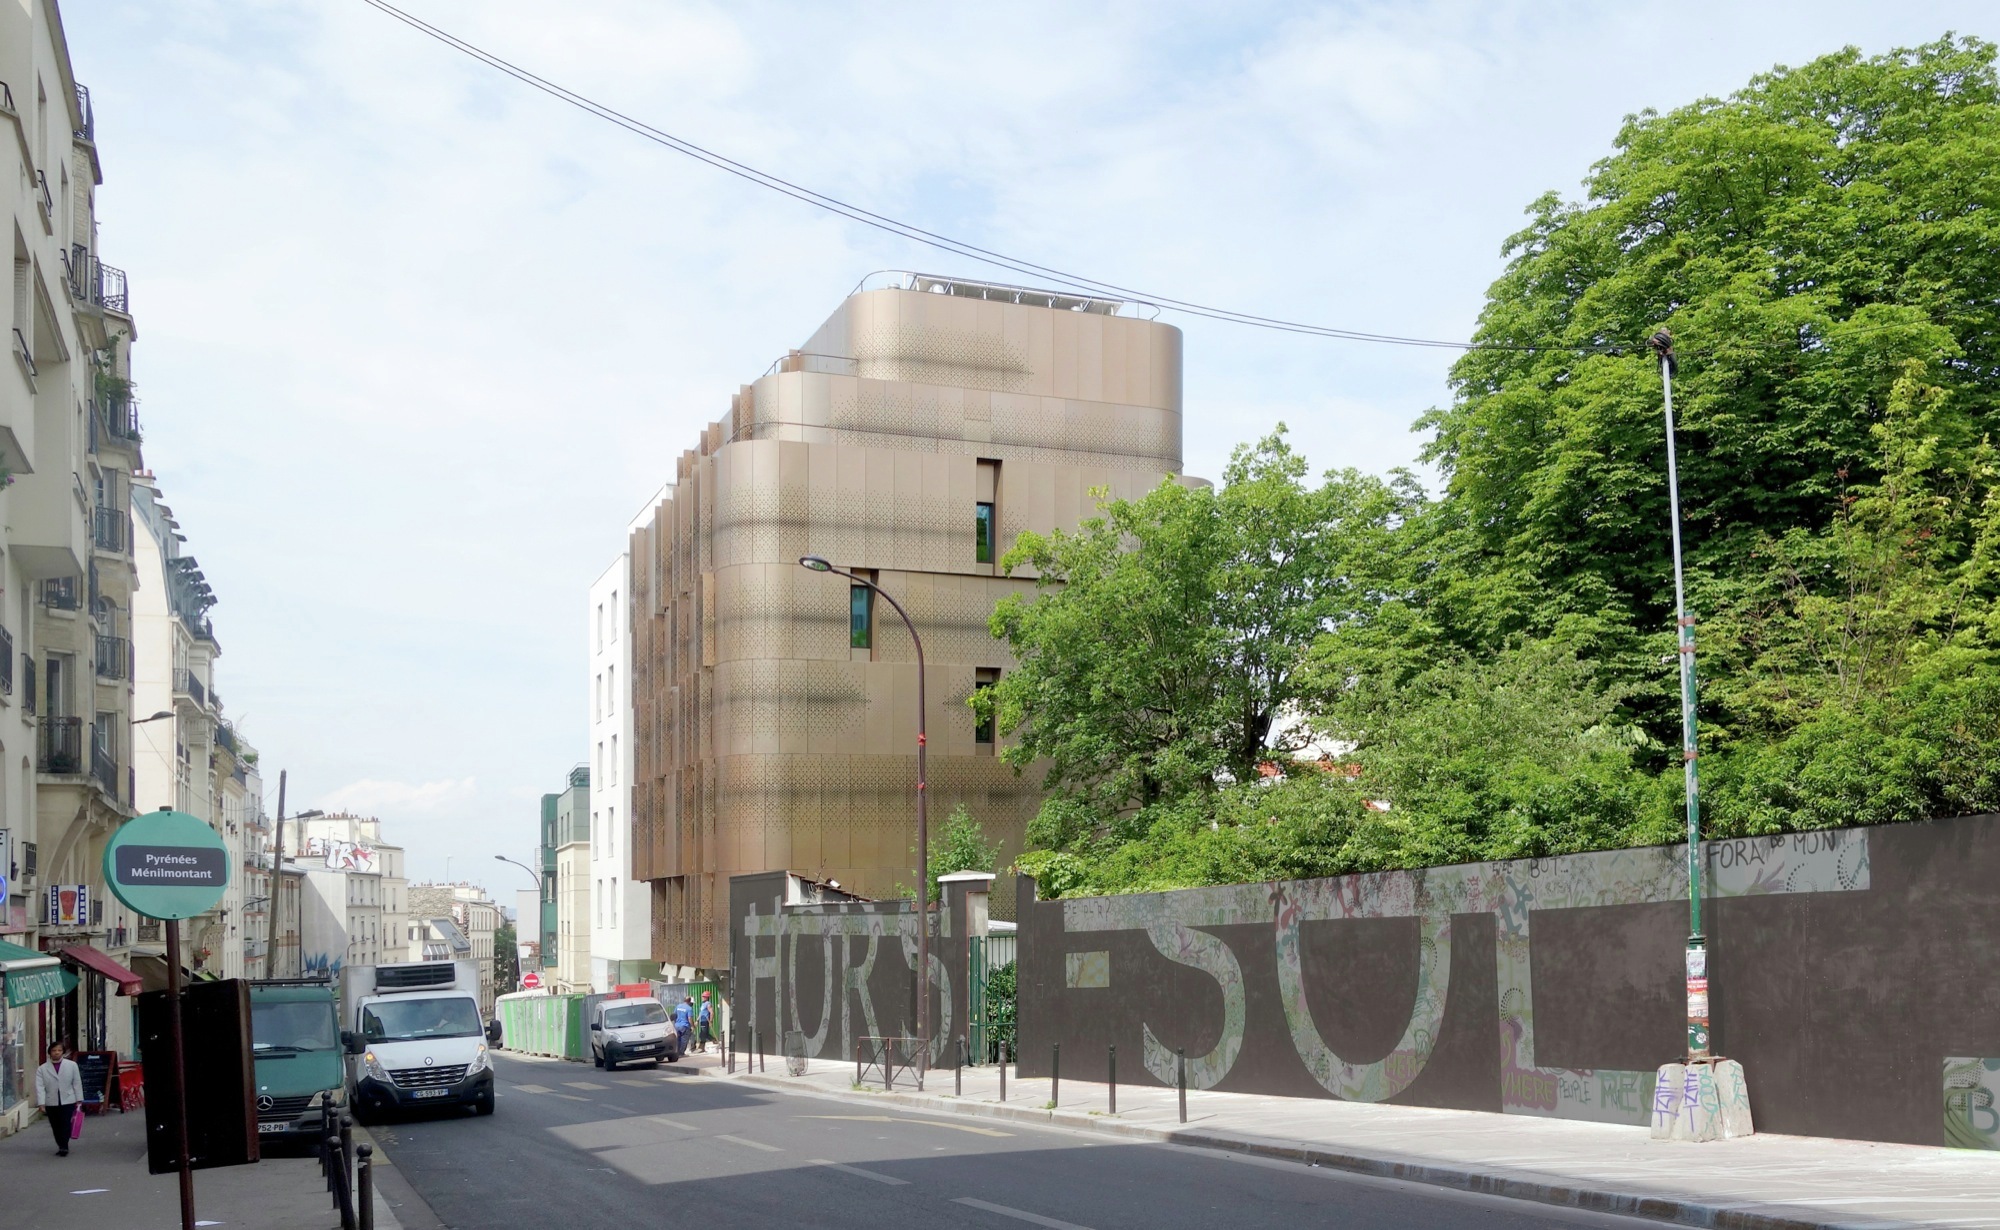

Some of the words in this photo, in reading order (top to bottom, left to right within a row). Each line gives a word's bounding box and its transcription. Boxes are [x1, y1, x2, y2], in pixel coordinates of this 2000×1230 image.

[146, 854, 198, 866] Pyrénées
[1706, 839, 1766, 869] FORA
[131, 867, 212, 879] Ménilmontant
